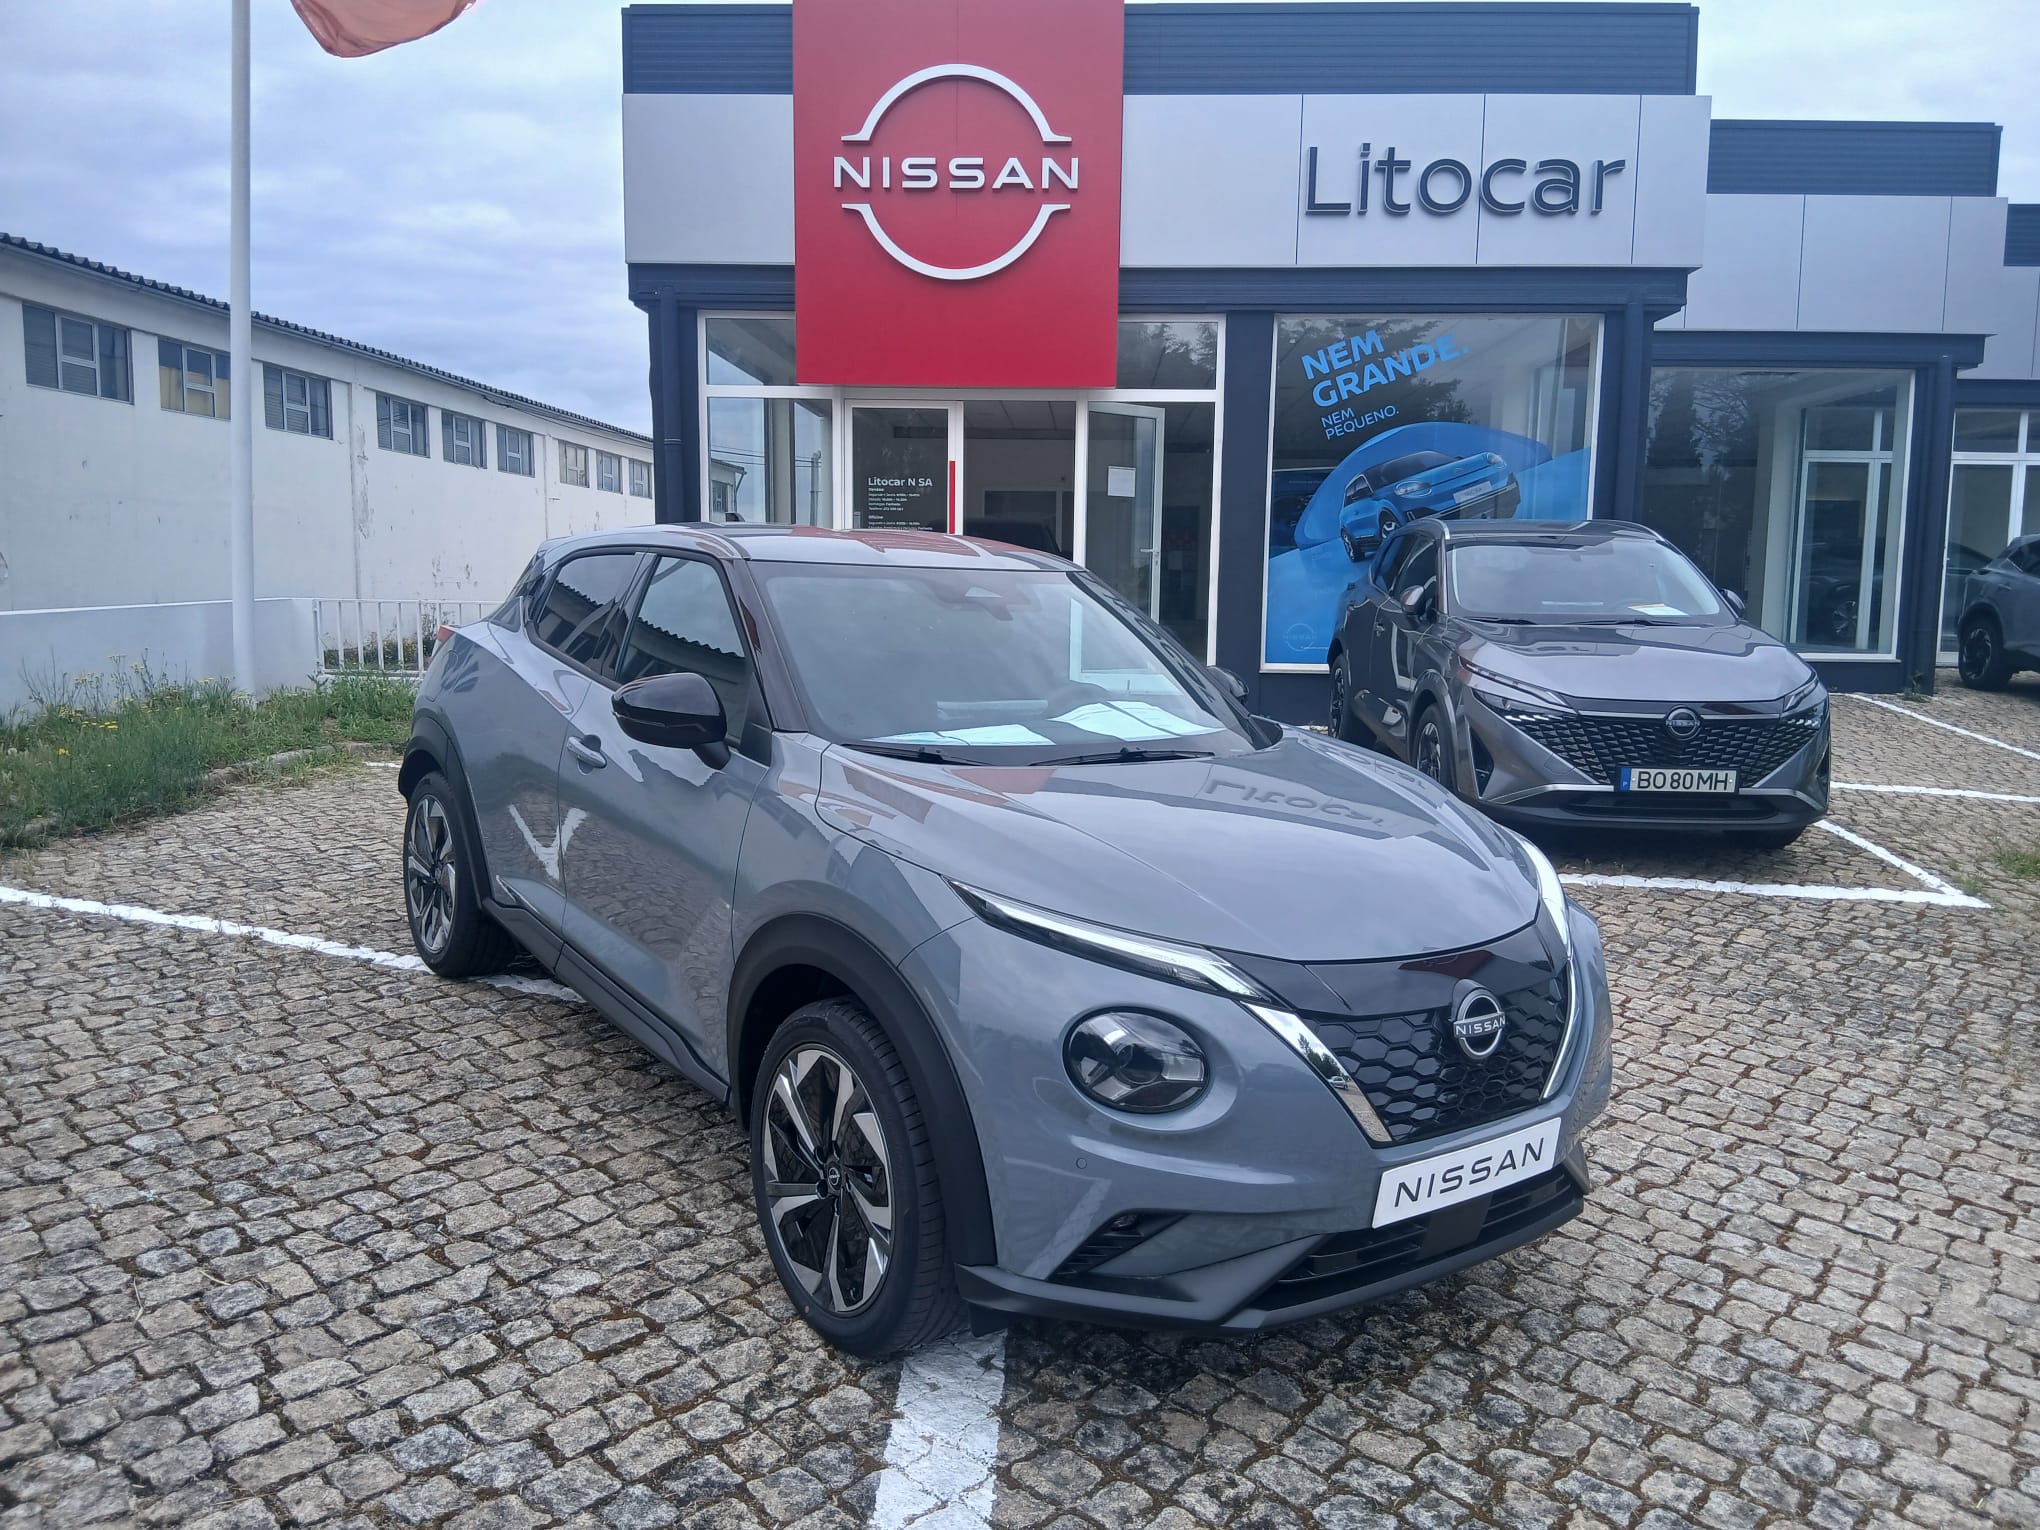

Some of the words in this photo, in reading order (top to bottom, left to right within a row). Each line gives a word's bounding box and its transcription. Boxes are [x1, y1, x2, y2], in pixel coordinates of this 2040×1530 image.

[833, 156, 1079, 191] NISSAN
[1305, 142, 1626, 217] Litocar
[1301, 329, 1385, 380] NEM
[1312, 331, 1471, 407] GRANDE.
[1321, 407, 1356, 428] NEM
[1325, 405, 1400, 440] PEQUENO.
[867, 476, 905, 487] Litocar
[907, 477, 916, 487] N
[918, 478, 933, 487] SA
[1455, 1015, 1506, 1036] NISSAN
[1394, 1137, 1544, 1208] NISSAN
